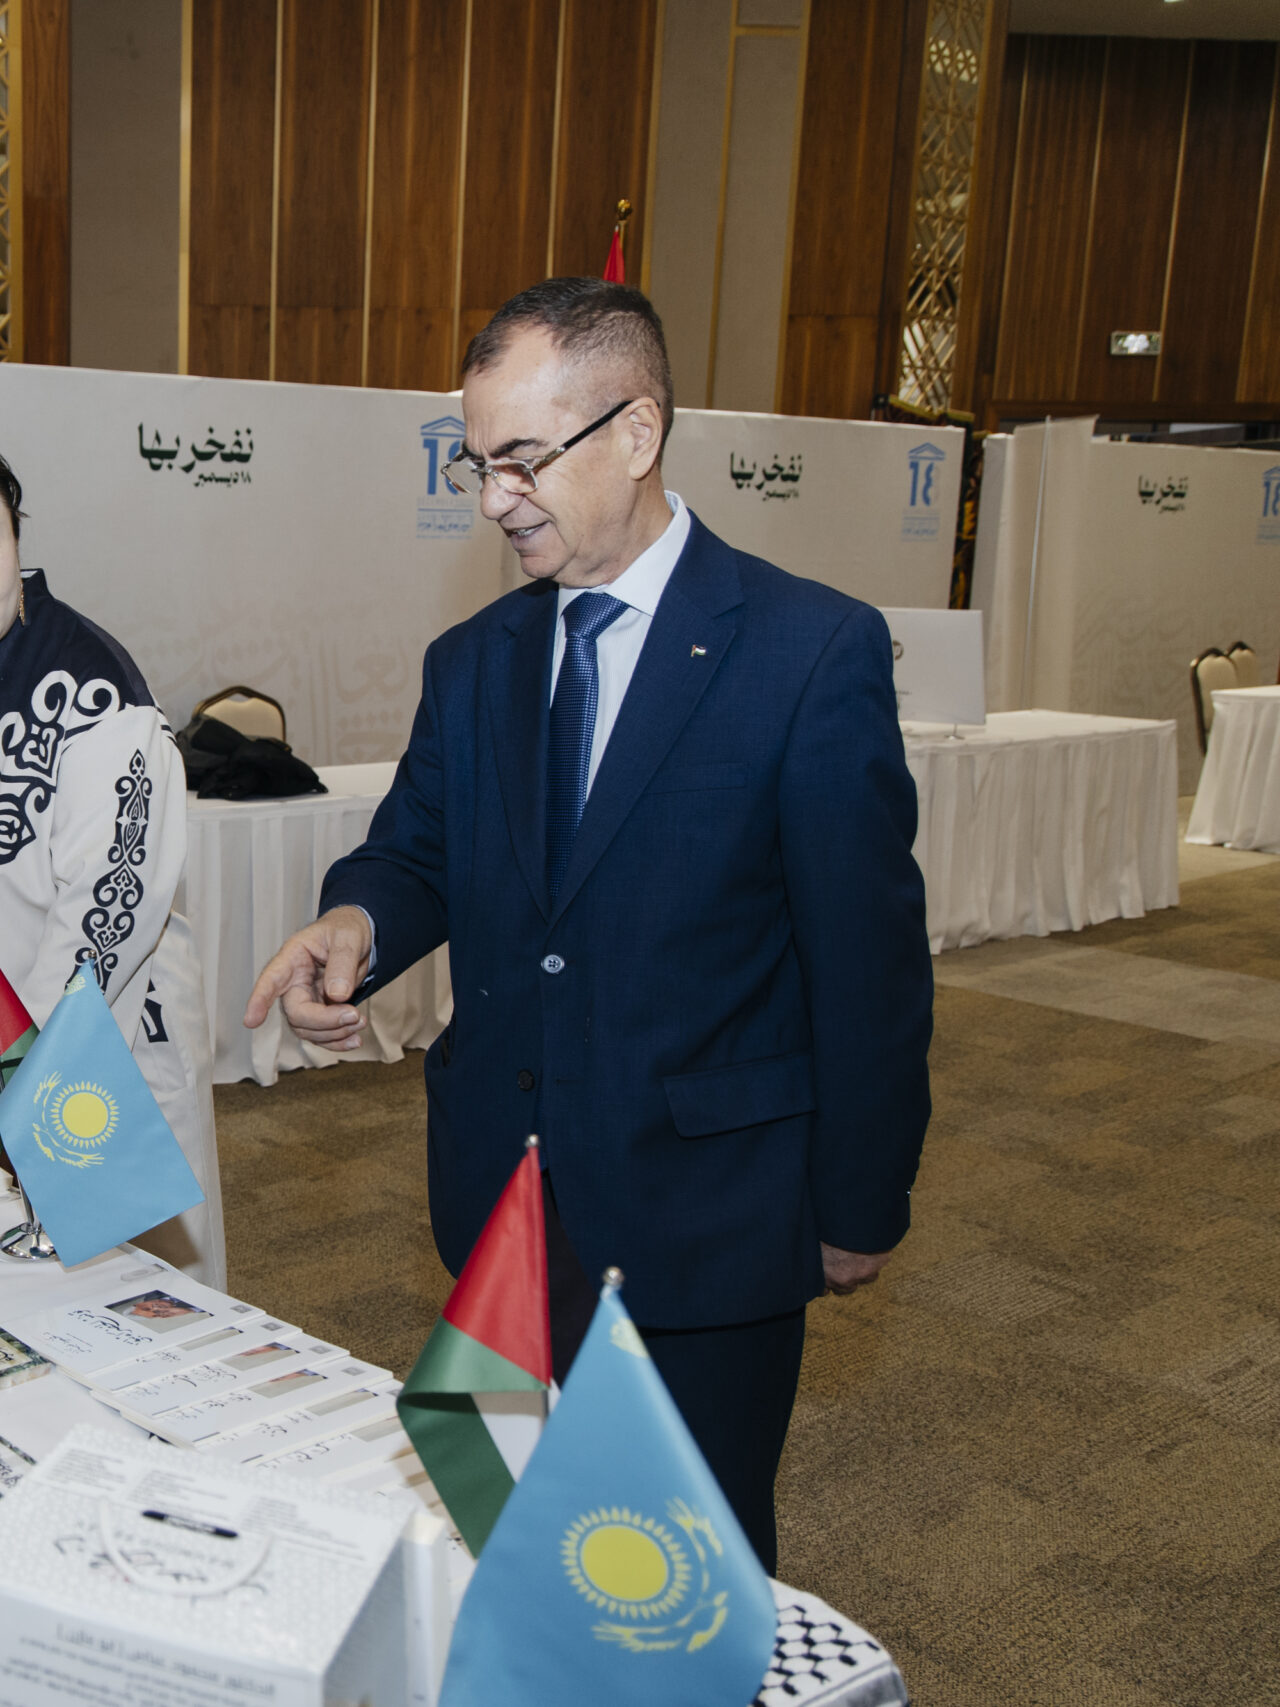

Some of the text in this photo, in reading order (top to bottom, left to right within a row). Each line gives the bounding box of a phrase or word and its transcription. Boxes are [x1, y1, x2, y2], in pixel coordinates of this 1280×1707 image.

[138, 421, 254, 474] نفخر بها
[730, 451, 803, 491] نفخر بها
